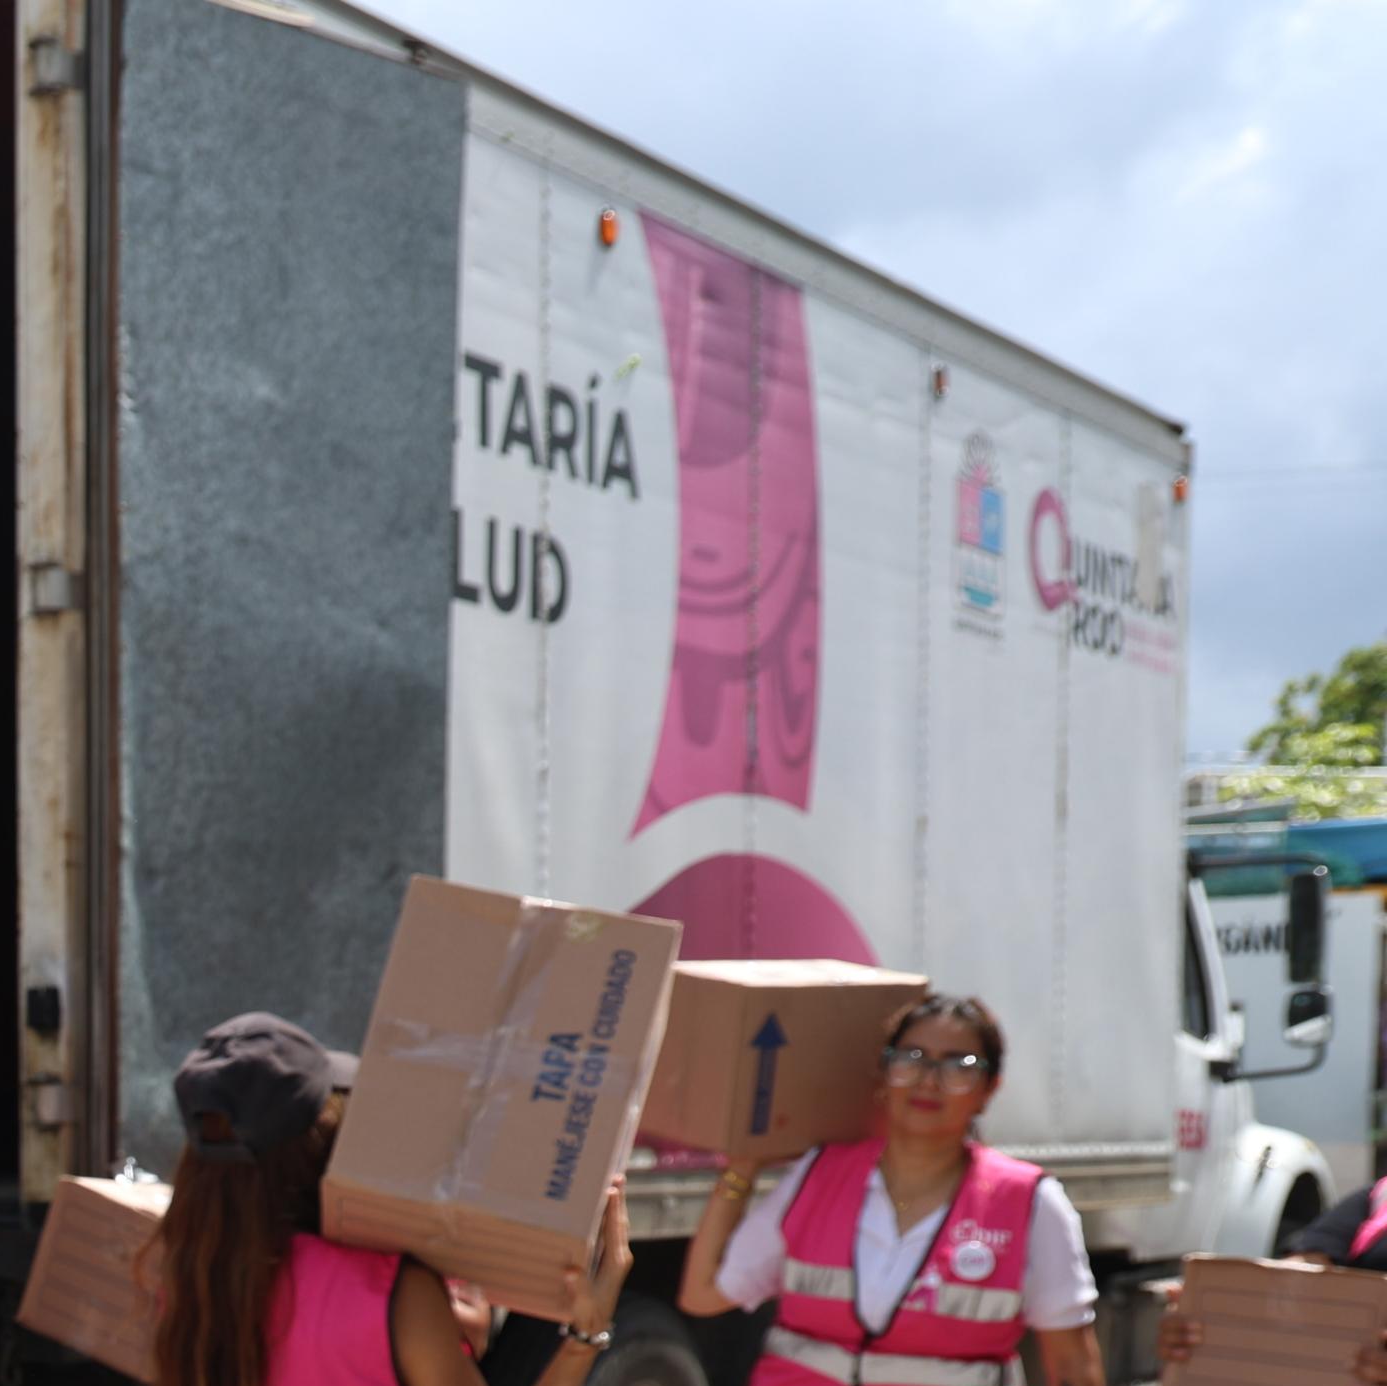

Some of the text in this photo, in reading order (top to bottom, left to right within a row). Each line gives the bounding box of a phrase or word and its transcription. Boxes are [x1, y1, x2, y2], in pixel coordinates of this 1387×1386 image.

[592, 948, 637, 1041] CUIDADO
[531, 1032, 583, 1102] TAPA
[578, 1042, 610, 1089] CON
